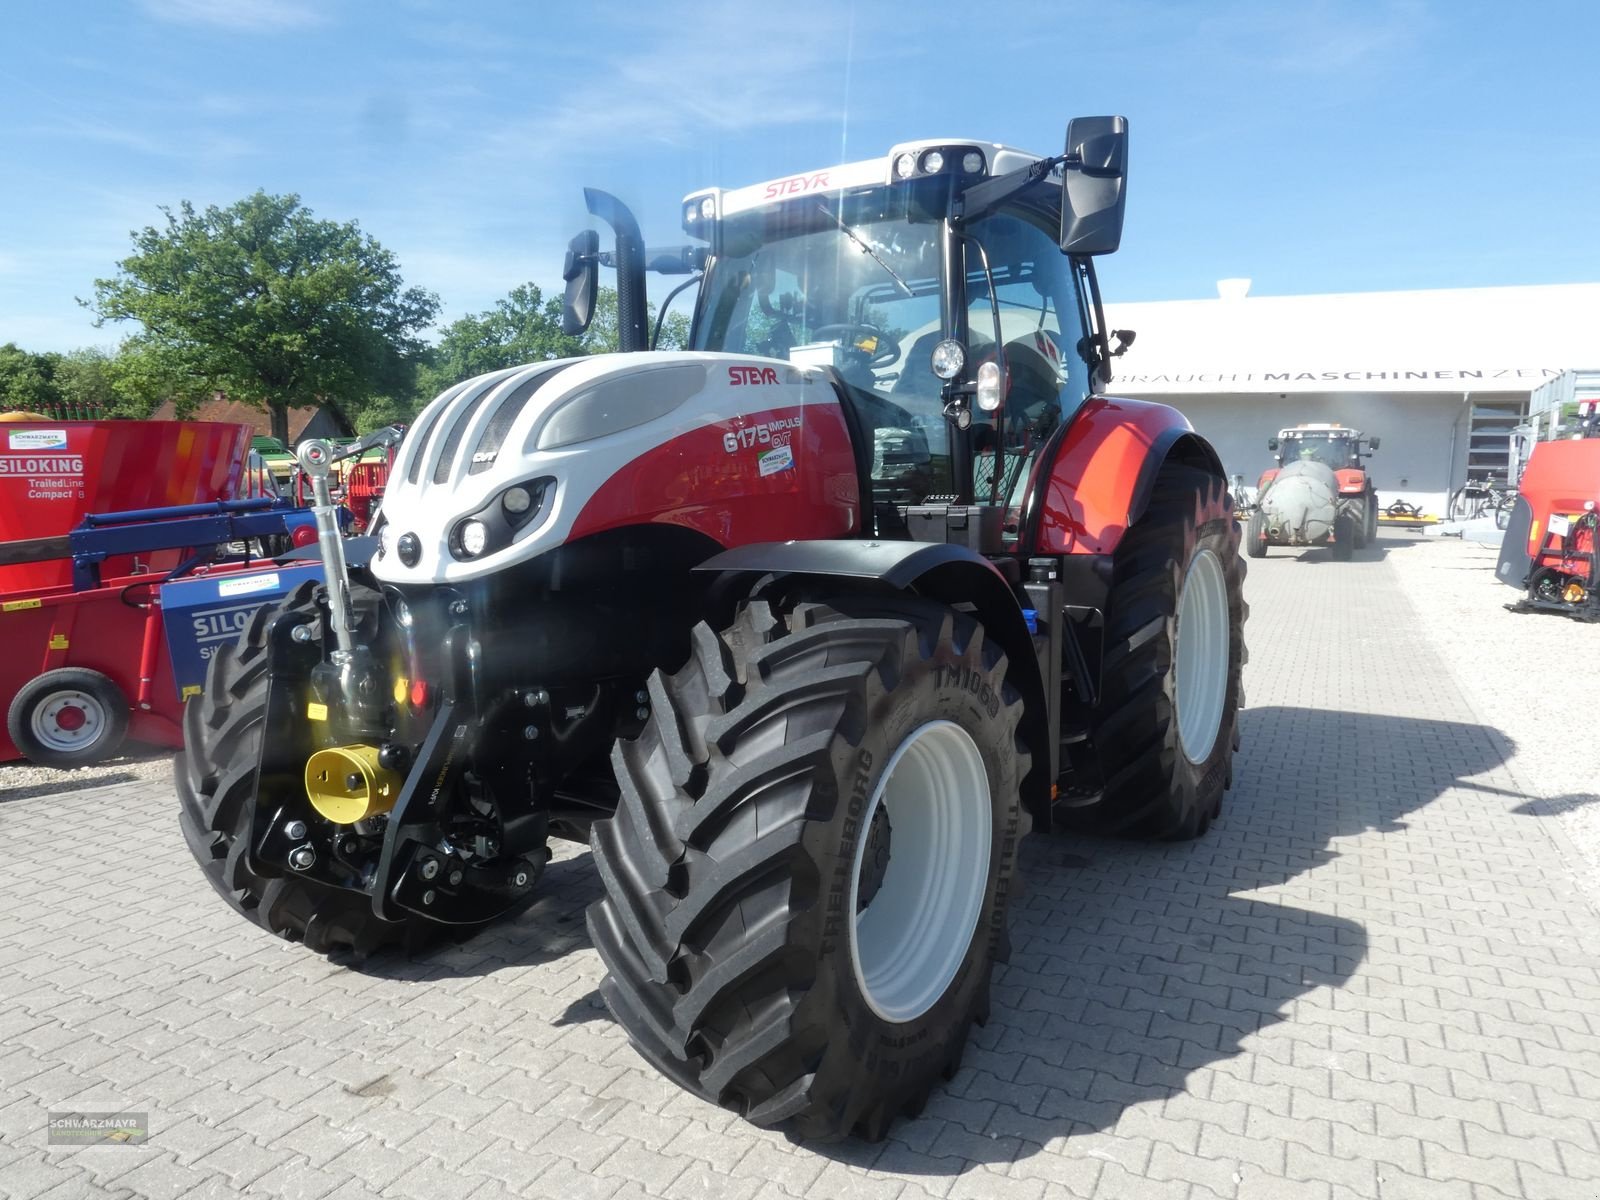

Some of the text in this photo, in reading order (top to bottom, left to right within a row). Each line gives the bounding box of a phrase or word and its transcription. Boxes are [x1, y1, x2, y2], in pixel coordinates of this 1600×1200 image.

[763, 172, 830, 199] STEYR
[728, 366, 780, 385] STEYR
[723, 417, 801, 453] 6175 IMPULS
[772, 431, 792, 448] CVT
[0, 459, 84, 473] SILOKING
[28, 479, 85, 488] TrailedLine
[28, 490, 72, 500] Compact
[193, 609, 256, 636] SILO
